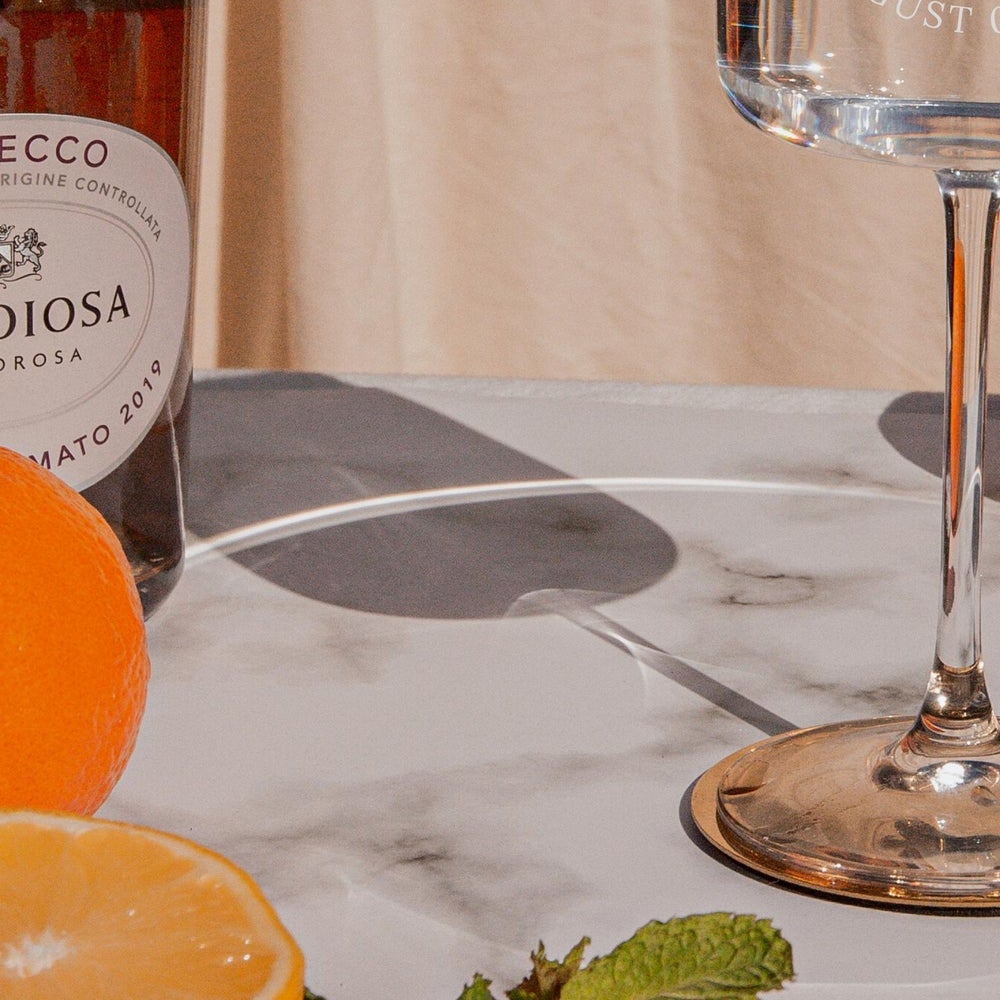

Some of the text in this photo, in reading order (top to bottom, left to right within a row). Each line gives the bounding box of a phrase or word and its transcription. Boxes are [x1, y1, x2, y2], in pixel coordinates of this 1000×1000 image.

[0, 134, 108, 168] ECCO
[0, 172, 161, 242] RIGINE CONTROLLATA
[120, 360, 161, 424] 2019
